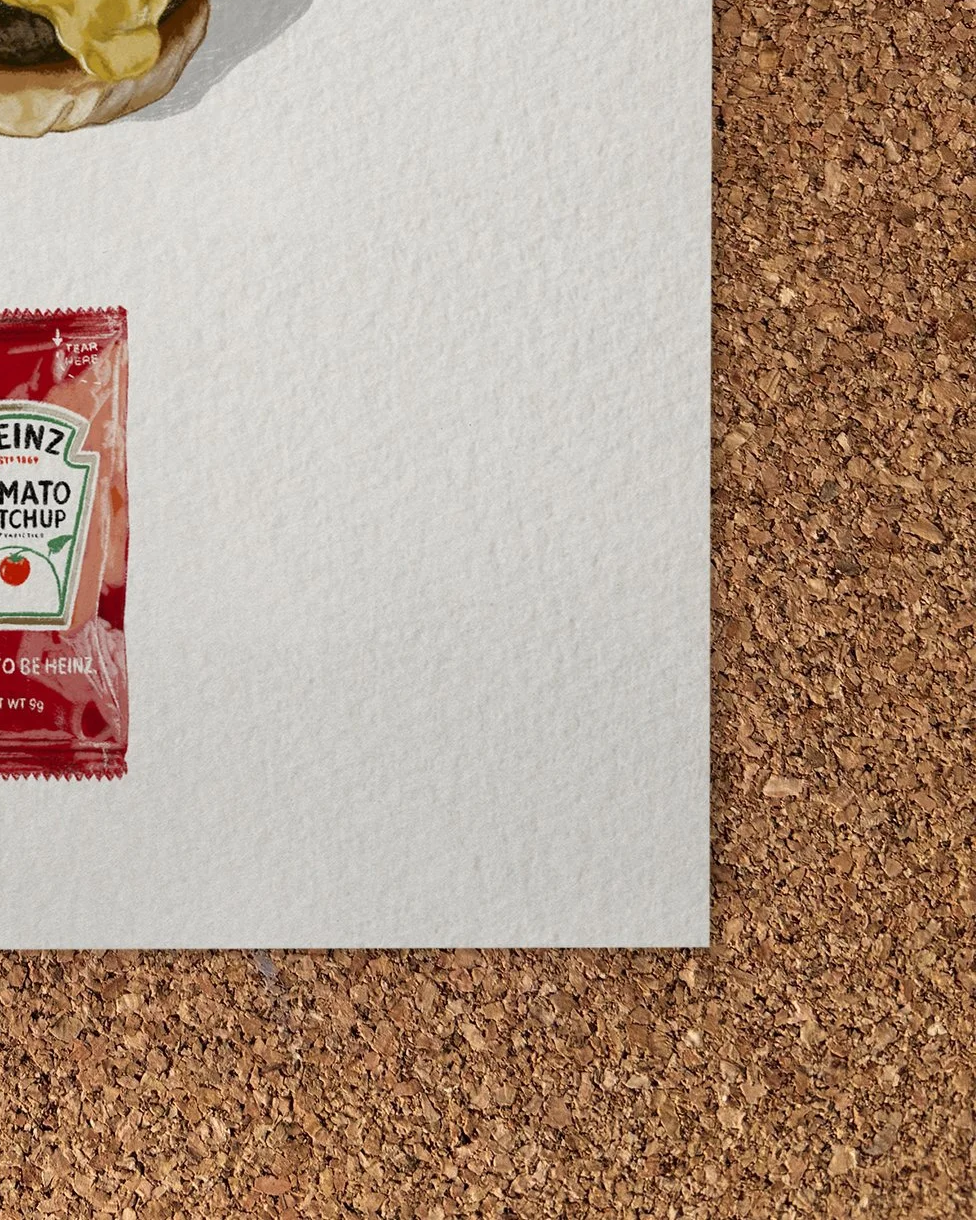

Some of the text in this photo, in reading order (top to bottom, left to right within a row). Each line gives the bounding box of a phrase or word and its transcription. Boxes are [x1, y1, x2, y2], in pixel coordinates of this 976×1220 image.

[65, 341, 98, 353] TEAR
[20, 657, 41, 675] BE
[7, 697, 26, 710] WT
